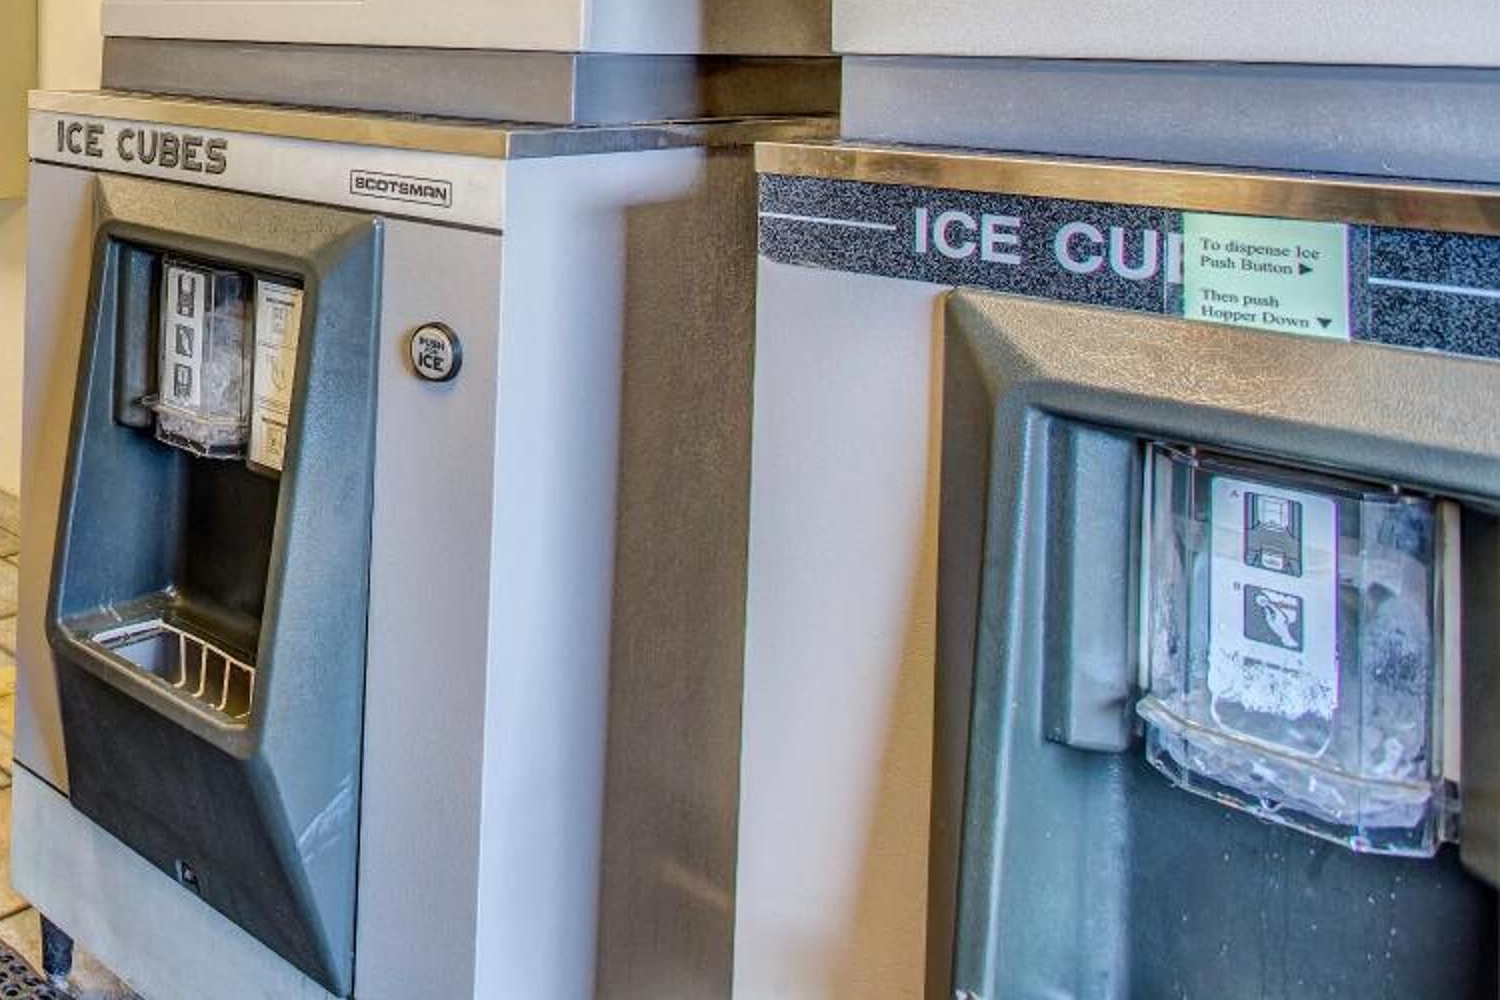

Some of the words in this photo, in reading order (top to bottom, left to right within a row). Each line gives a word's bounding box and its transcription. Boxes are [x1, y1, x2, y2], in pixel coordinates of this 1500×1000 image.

[57, 119, 104, 158] ICE
[117, 127, 228, 175] CUBES
[355, 177, 447, 201] SCOTSMAN
[915, 206, 1021, 265] ICE
[1201, 236, 1221, 251] To
[1225, 239, 1291, 258] dispense
[1295, 244, 1321, 260] Ice
[1201, 255, 1235, 269] Push
[1241, 258, 1293, 275] Button
[1202, 287, 1238, 303] Then
[1243, 293, 1279, 309] push
[1201, 304, 1257, 325] Hopper
[1262, 311, 1309, 329] Down
[418, 352, 445, 372] ICE
